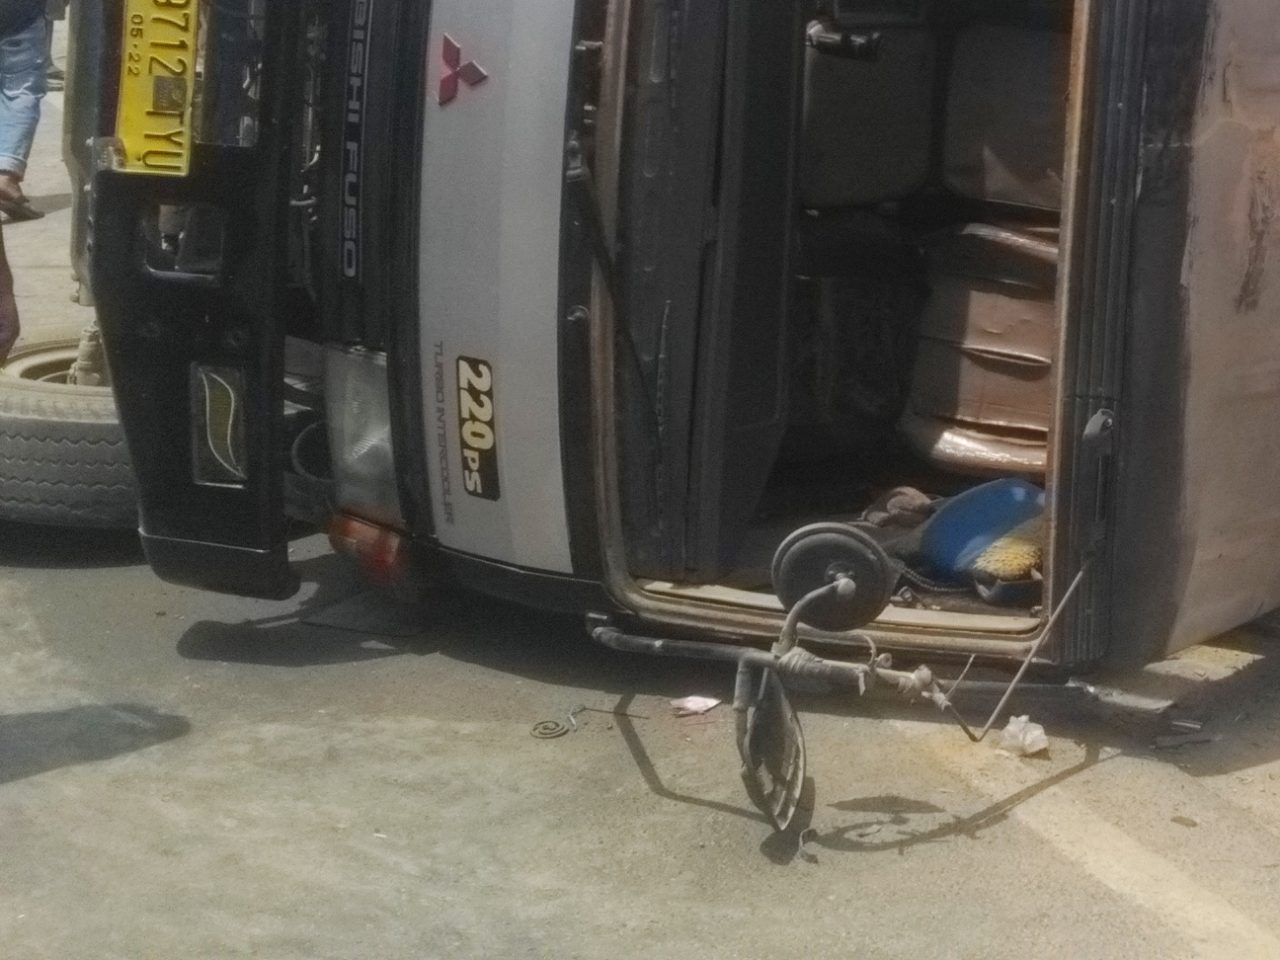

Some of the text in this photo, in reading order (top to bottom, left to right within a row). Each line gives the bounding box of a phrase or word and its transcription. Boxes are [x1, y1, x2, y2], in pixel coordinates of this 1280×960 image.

[142, 110, 185, 171] TYU
[342, 141, 359, 279] FUSO
[433, 341, 455, 526] TURBO INTERCOOLER
